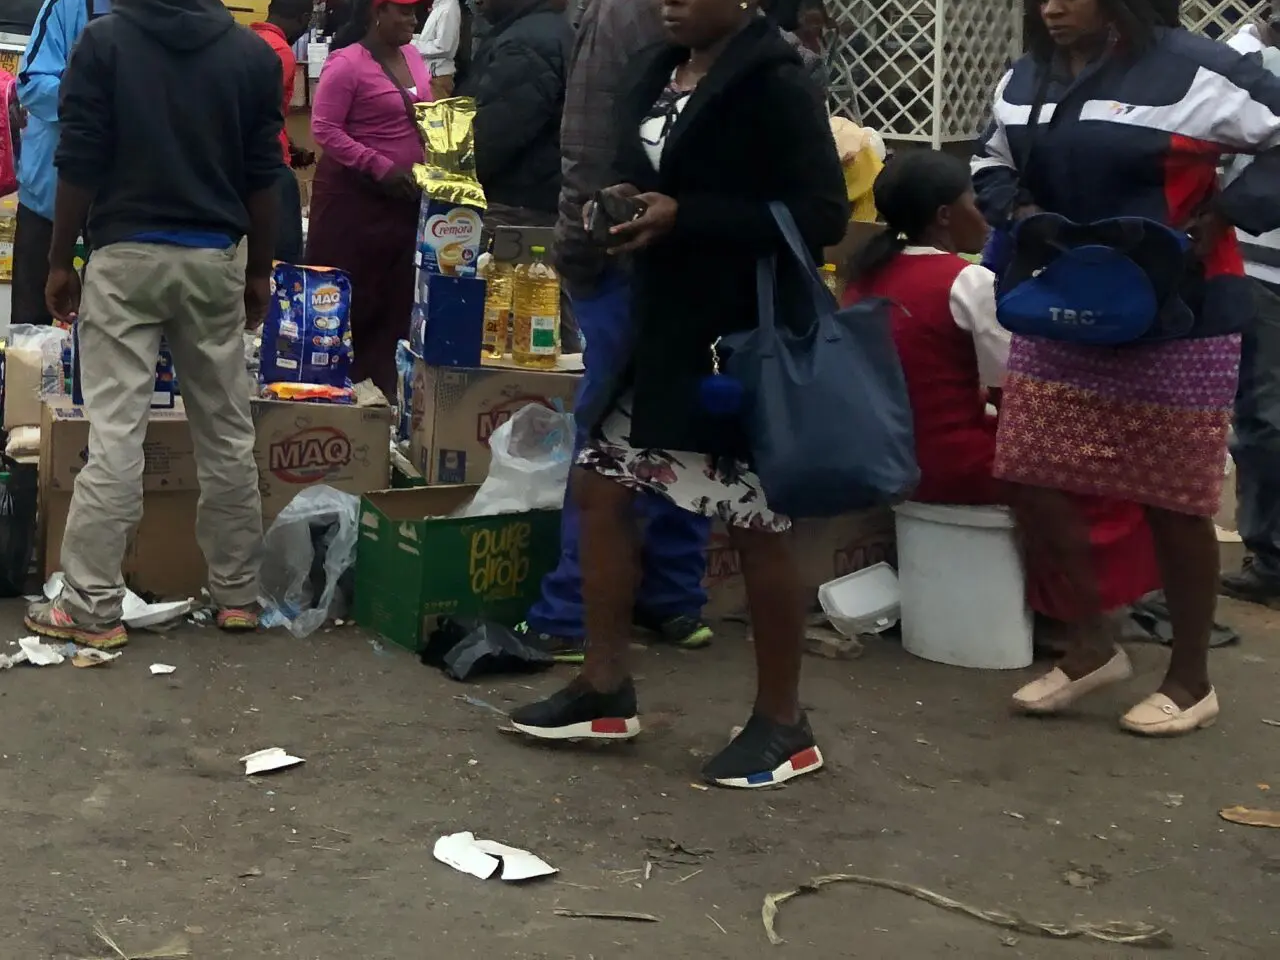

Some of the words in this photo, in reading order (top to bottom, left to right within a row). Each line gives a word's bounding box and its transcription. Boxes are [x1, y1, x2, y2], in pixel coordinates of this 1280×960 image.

[432, 220, 473, 238] Cremora
[312, 291, 340, 305] MAQ
[270, 436, 351, 471] MAQ
[470, 523, 531, 573] pure
[472, 557, 529, 592] drop
